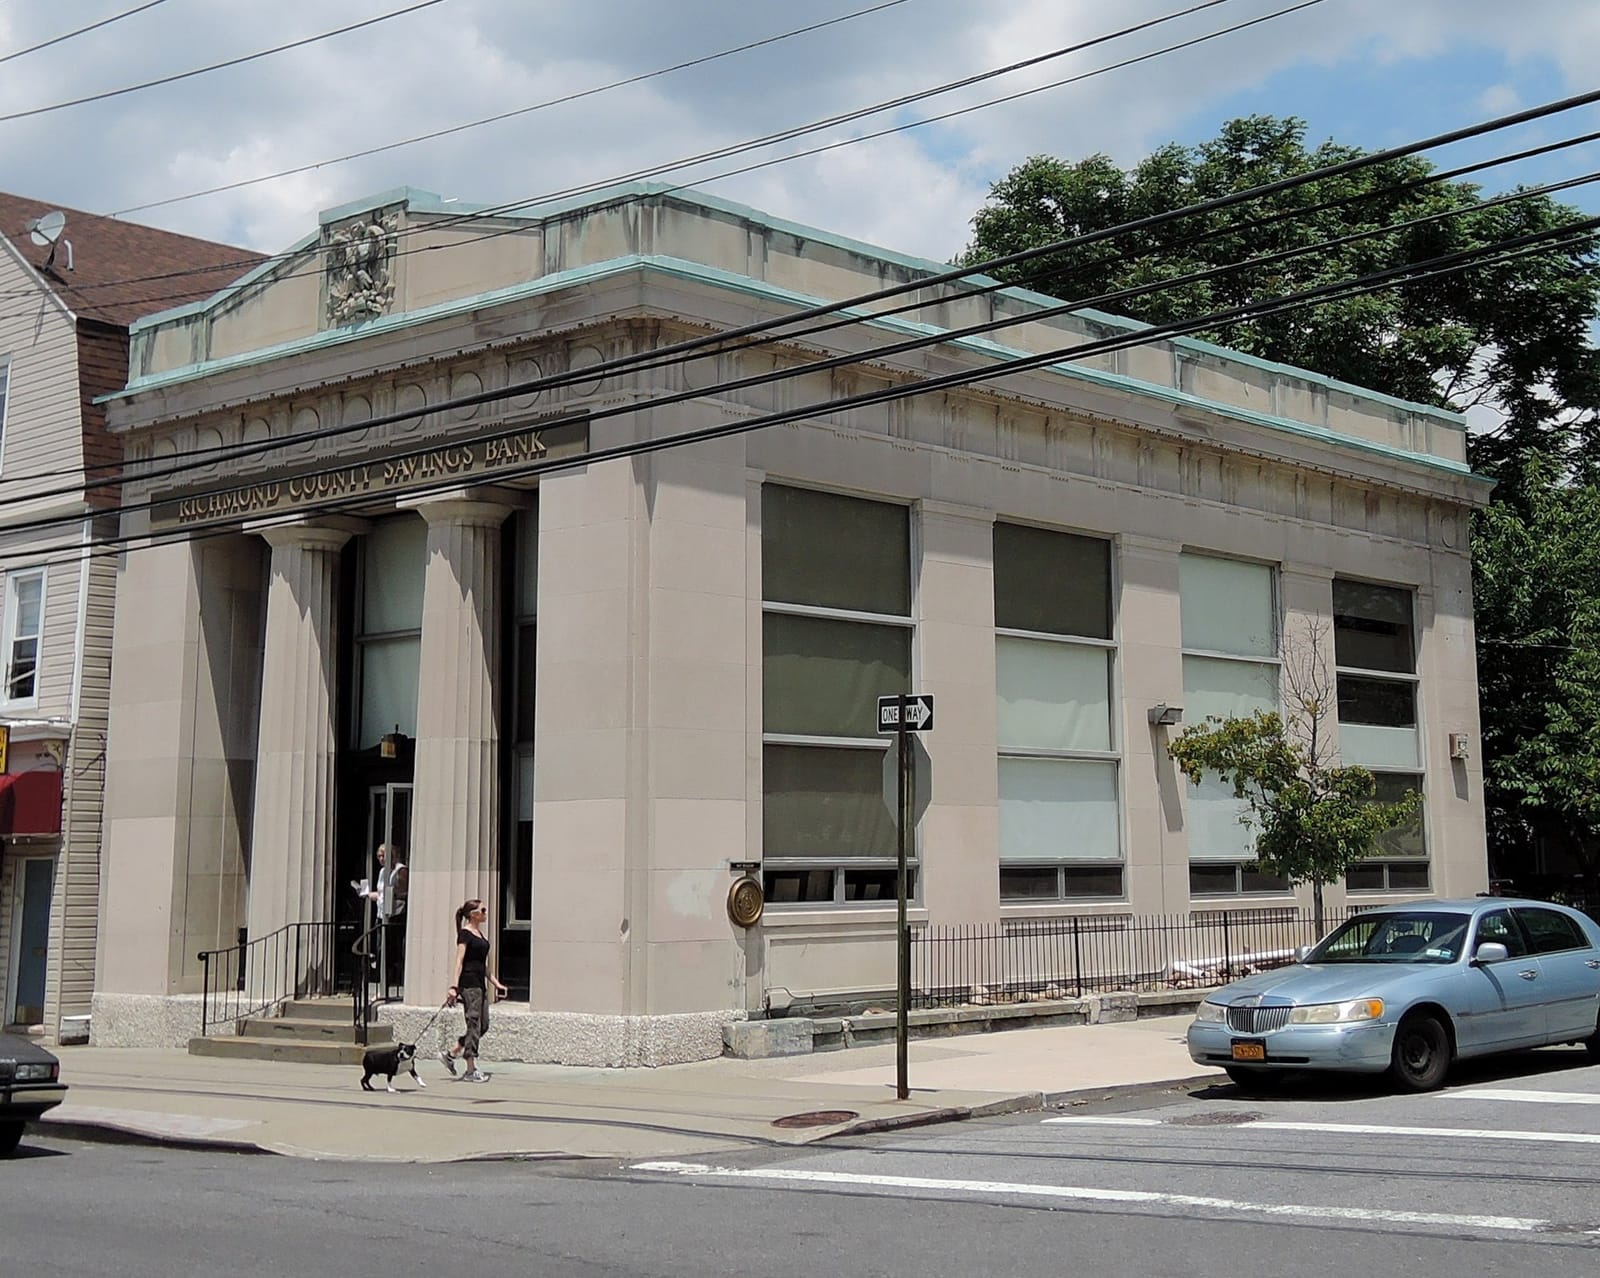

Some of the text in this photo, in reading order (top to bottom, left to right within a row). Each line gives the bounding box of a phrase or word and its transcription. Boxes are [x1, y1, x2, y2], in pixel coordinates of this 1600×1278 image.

[179, 430, 546, 518] RICHMOND COUNTY SAVINGS BANK
[882, 705, 923, 722] ONE WAY
